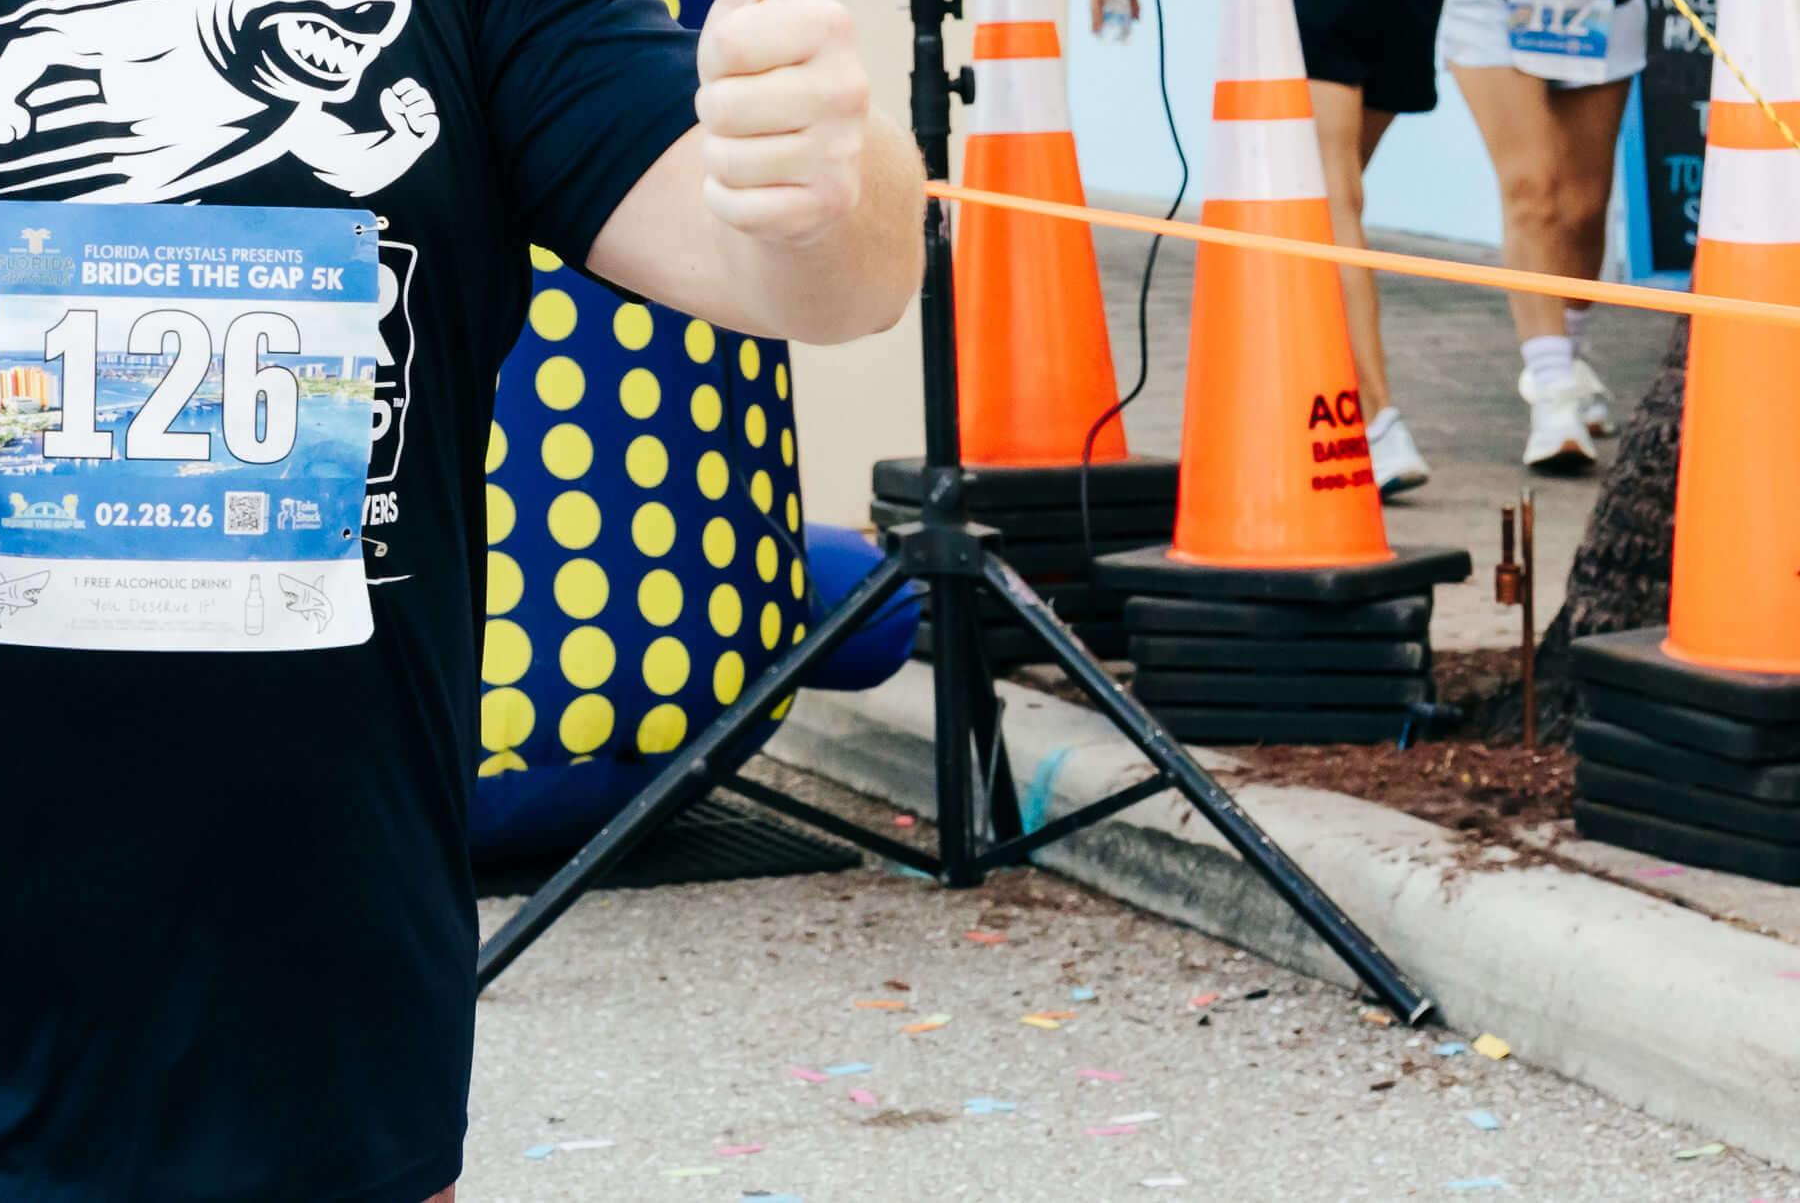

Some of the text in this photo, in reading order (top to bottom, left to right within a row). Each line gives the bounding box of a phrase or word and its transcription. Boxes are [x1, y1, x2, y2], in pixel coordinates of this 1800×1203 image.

[84, 244, 303, 264] FLORIDA CRYSTALS PRESENTS
[81, 261, 344, 291] BRIDGE THE GAP 5K
[42, 308, 302, 466] 126
[94, 502, 214, 529] 02.28.26
[83, 577, 111, 588] FREE
[114, 577, 187, 589] ALCOHOLIC
[191, 578, 232, 590] DRINK!
